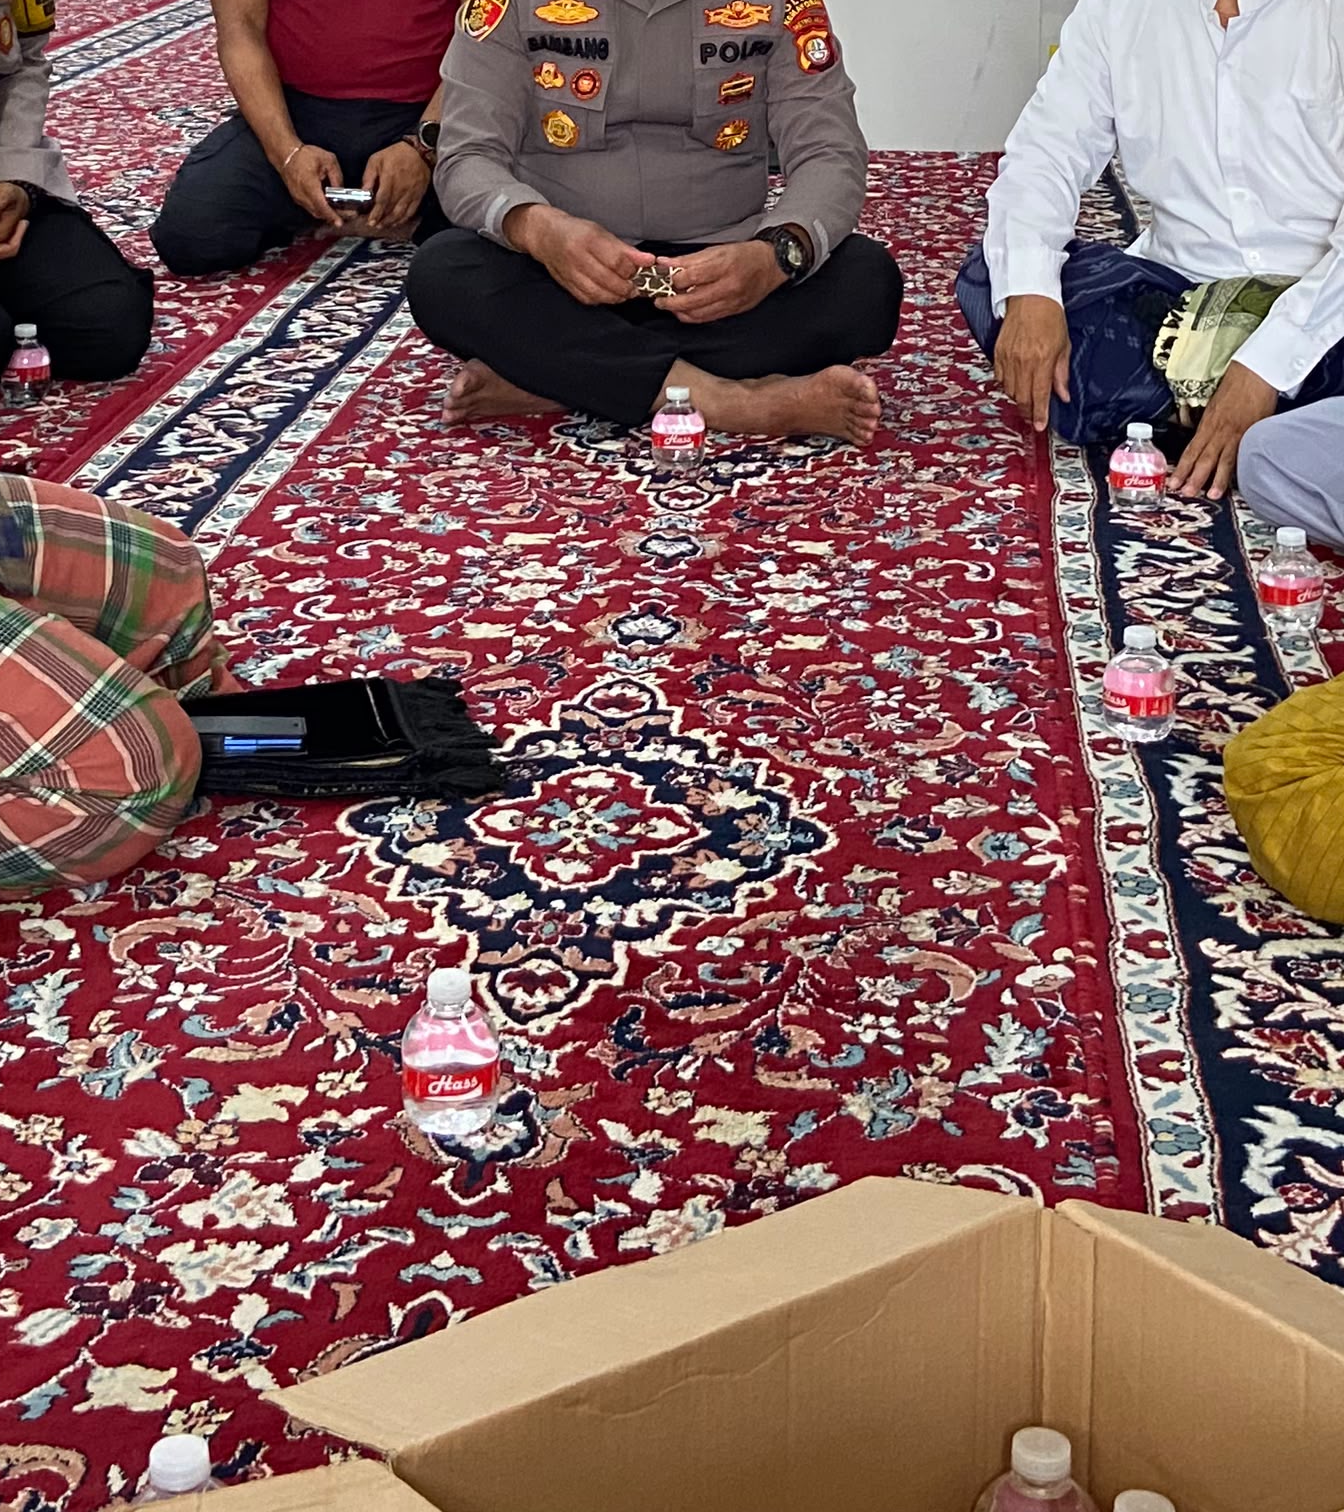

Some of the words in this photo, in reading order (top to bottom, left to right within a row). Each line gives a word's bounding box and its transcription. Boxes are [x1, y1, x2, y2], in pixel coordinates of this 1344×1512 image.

[663, 433, 693, 445] Hass
[1123, 475, 1154, 487] Hass
[427, 1074, 479, 1095] Hass
